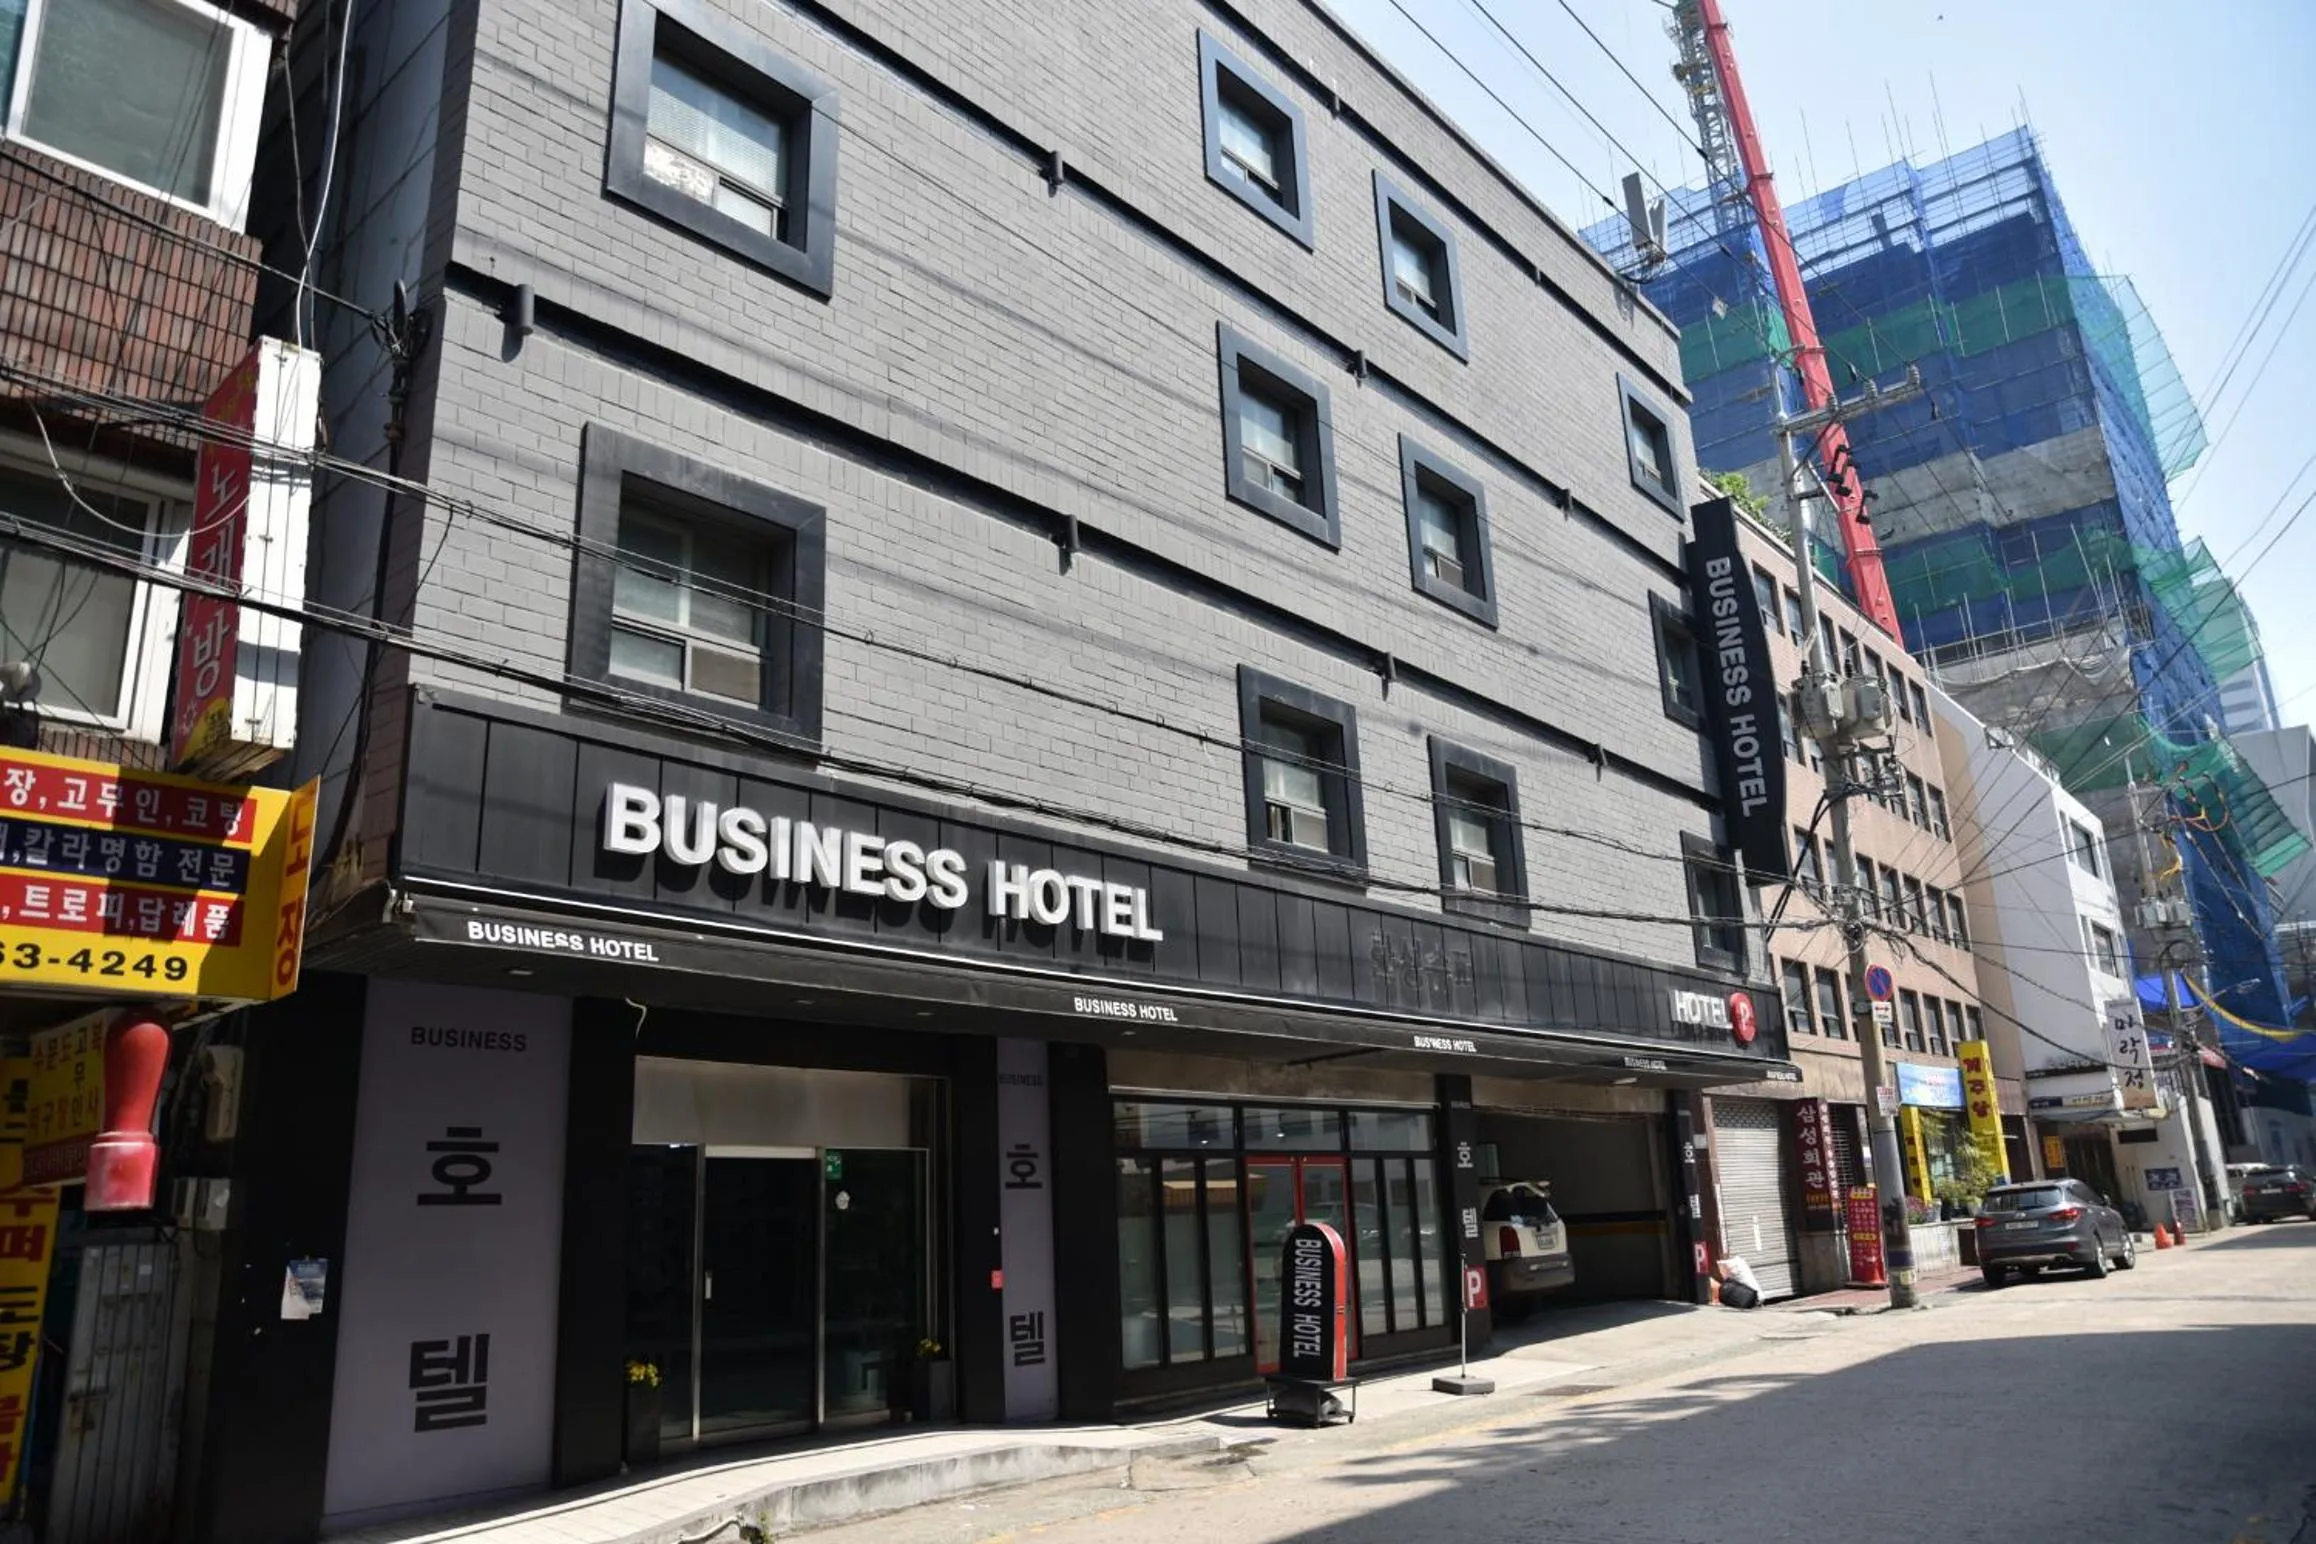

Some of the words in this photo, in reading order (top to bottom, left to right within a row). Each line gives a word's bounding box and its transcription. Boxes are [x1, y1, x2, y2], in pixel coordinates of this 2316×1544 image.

[194, 463, 239, 698] 노래방
[1705, 556, 1752, 707] BUSINESS
[1729, 713, 1768, 818] HOTEL
[602, 782, 968, 910] BUSINESS
[987, 858, 1164, 942] HOTEL
[0, 938, 188, 981] 3-4249
[467, 920, 585, 952] BUSINESS
[590, 935, 660, 962] HOTEL
[1073, 995, 1138, 1020] BUSINESS
[1140, 1003, 1178, 1024] HOTEL
[1669, 989, 1734, 1029] HOTEL
[410, 1026, 528, 1052] BUSINESS
[1797, 1105, 1825, 1189] 삼성회관
[1293, 1238, 1322, 1309] BUSINESS
[1694, 1242, 1705, 1273] P
[1467, 1270, 1482, 1308] P
[1293, 1310, 1321, 1359] HOTEL
